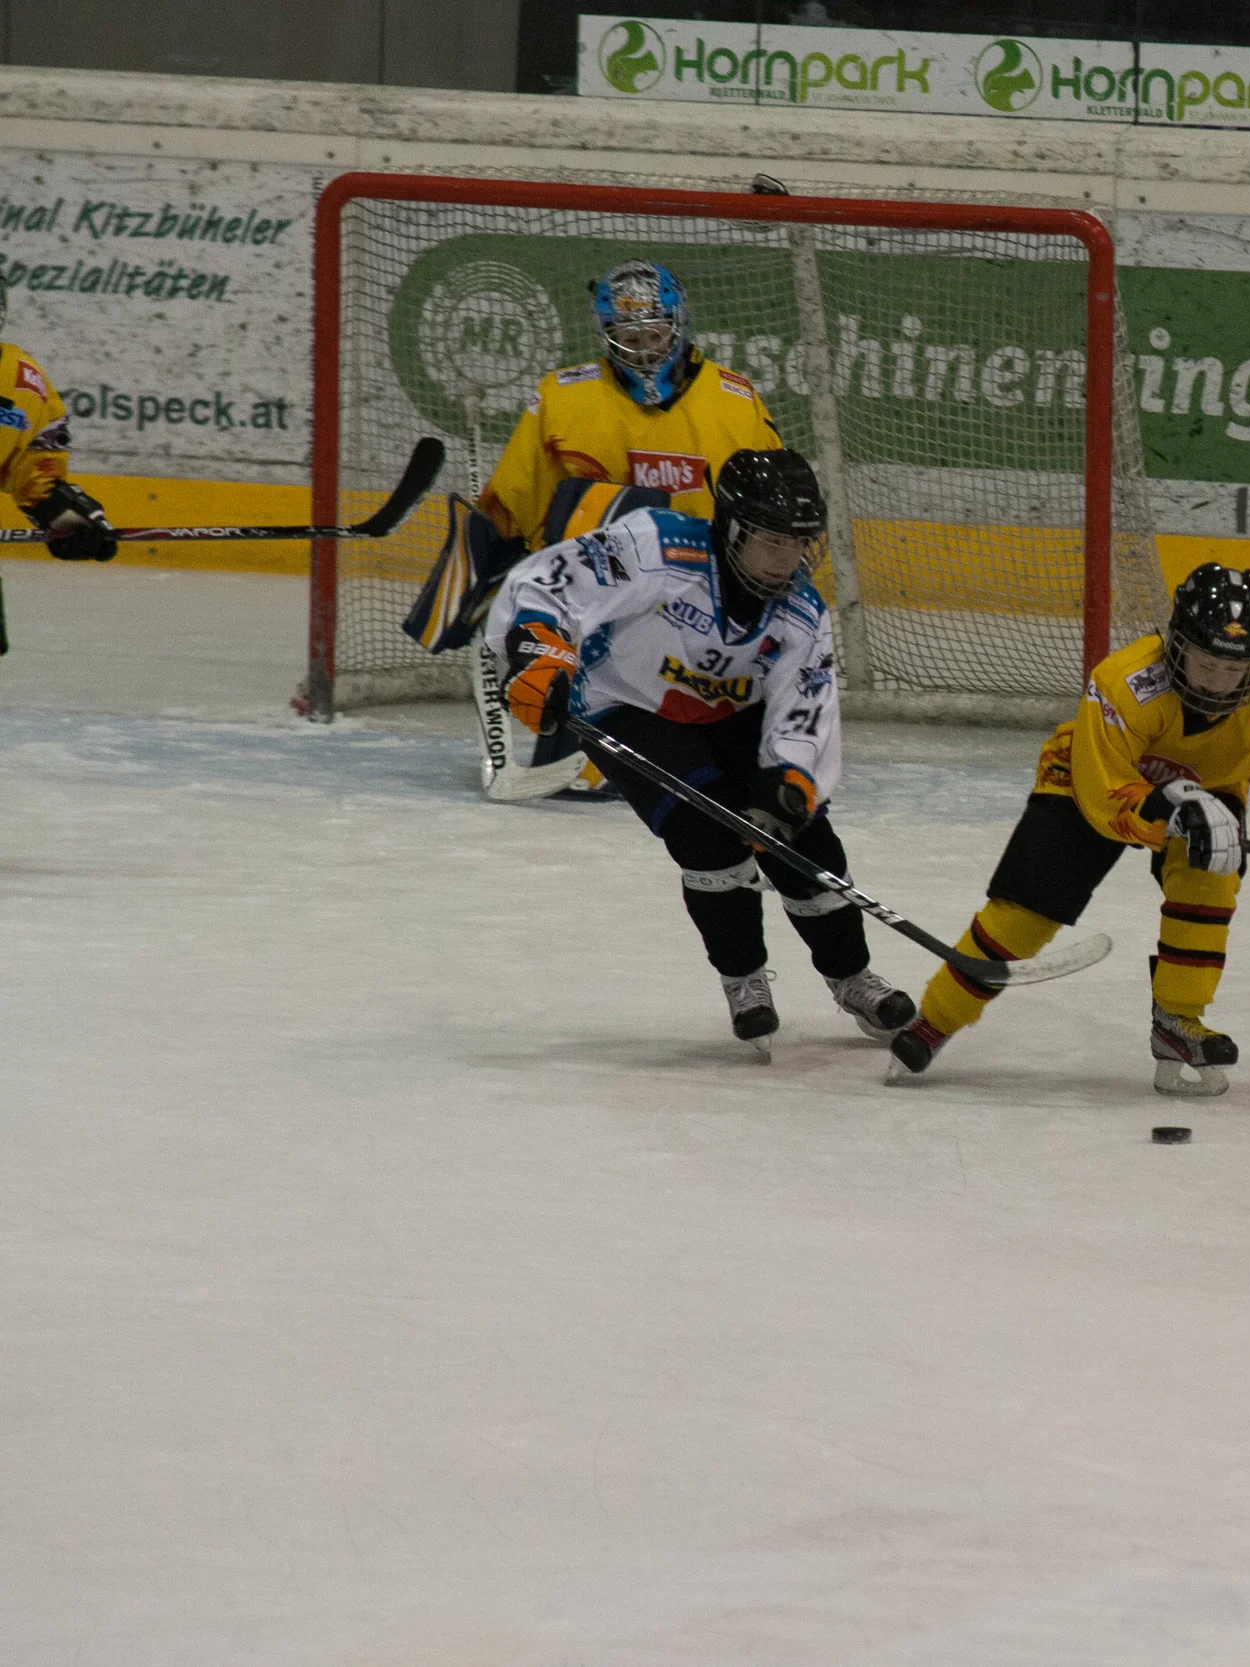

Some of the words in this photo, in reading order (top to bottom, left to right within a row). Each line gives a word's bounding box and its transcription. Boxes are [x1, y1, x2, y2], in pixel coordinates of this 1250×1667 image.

[674, 38, 931, 103] Hornpark
[0, 198, 63, 233] nal
[73, 200, 293, 246] Kitzbüheler
[633, 460, 694, 490] Kelly's
[1212, 636, 1247, 652] Reebok
[696, 649, 734, 677] 31
